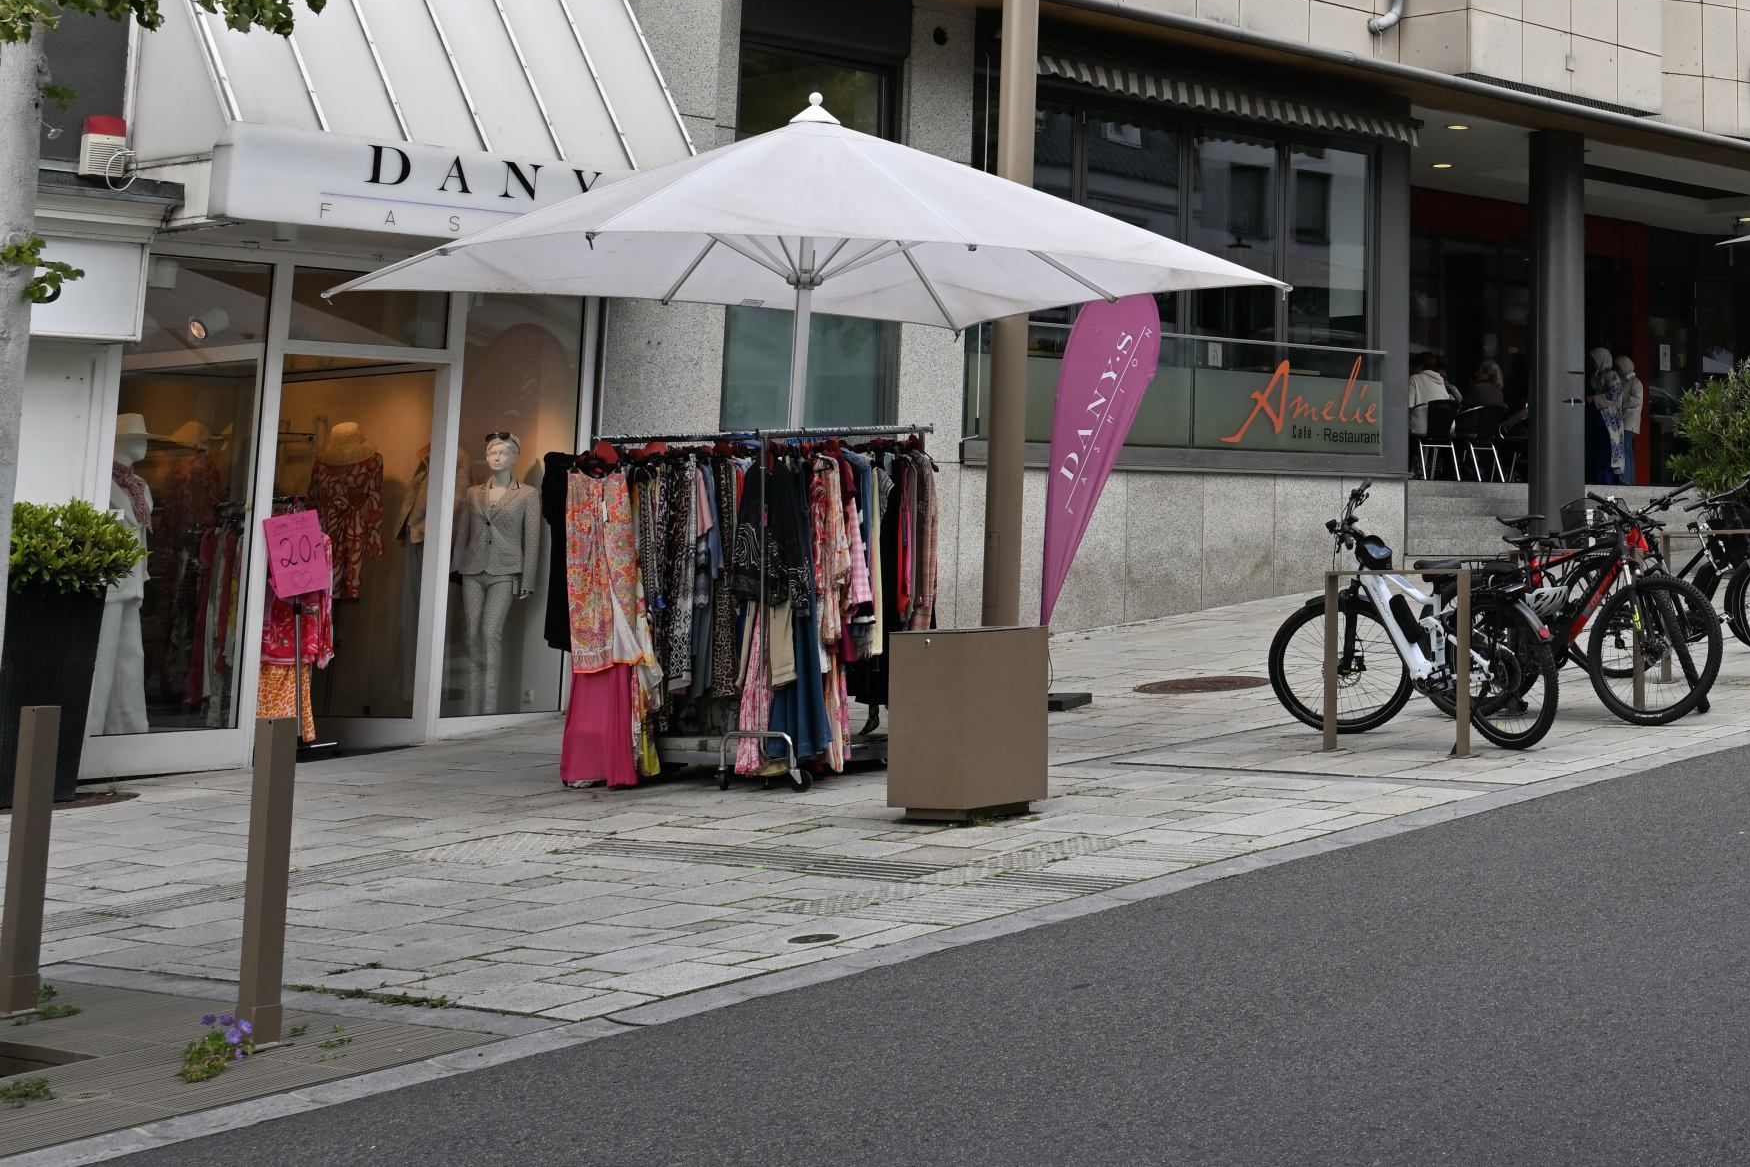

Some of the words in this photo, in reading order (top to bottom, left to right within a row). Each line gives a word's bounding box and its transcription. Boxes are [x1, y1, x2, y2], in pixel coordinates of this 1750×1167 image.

[1067, 328, 1153, 515] FASHION
[1220, 355, 1378, 443] Amelie
[1292, 424, 1312, 439] Café
[1324, 428, 1380, 444] Restaurant
